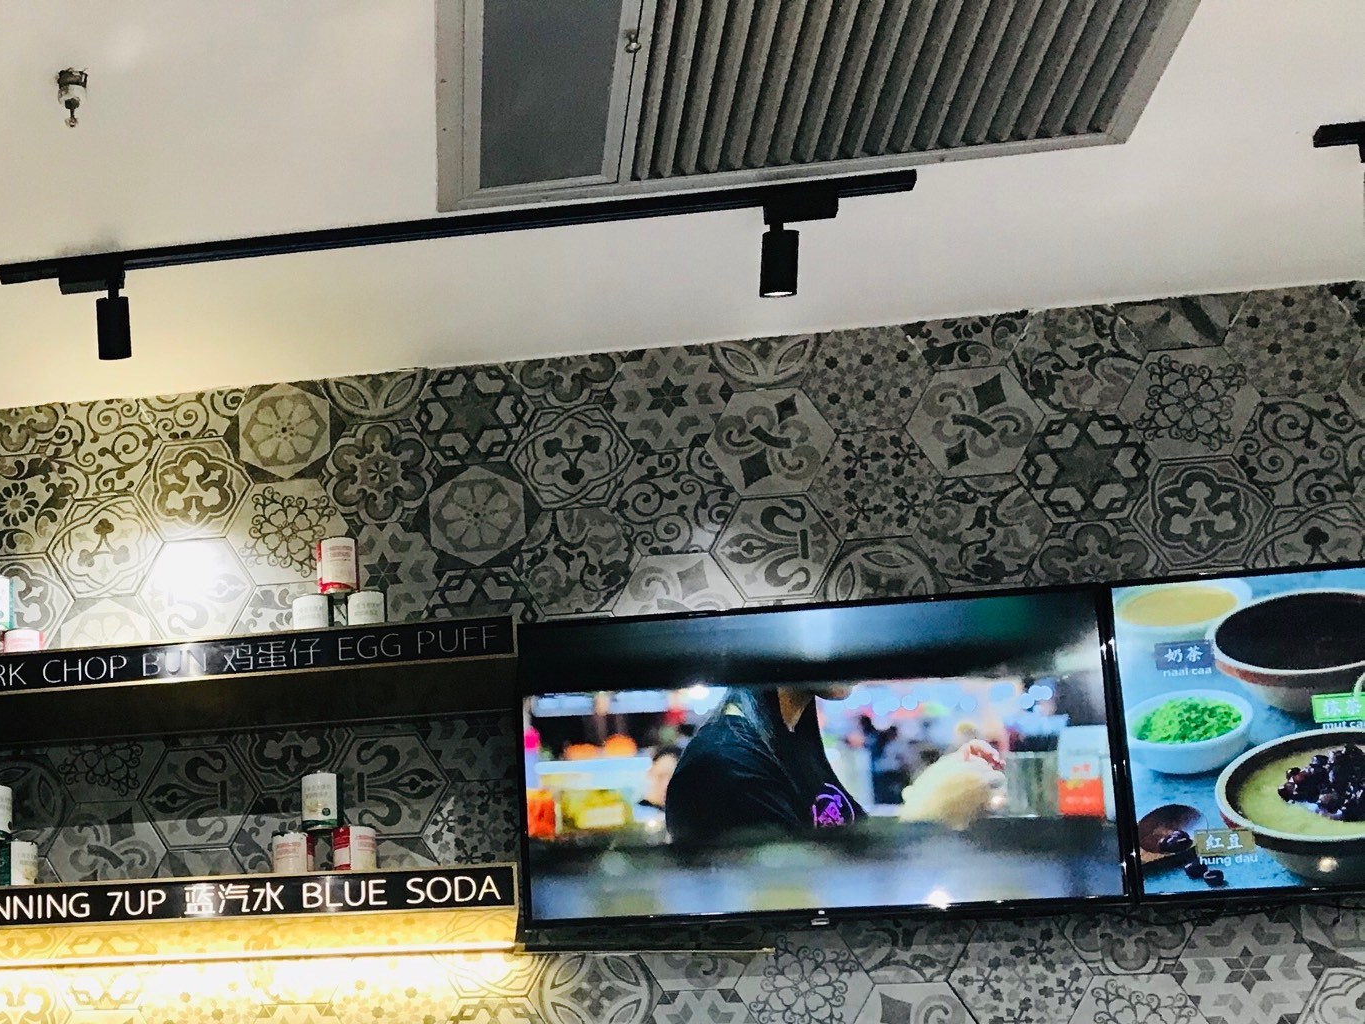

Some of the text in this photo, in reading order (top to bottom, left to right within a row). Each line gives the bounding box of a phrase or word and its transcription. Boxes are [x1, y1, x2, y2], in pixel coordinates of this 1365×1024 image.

[42, 654, 128, 684] CHOP
[142, 649, 208, 677] BUN
[222, 638, 322, 673] 鸡蛋仔
[337, 633, 402, 662] EGG
[417, 625, 498, 655] PUFF
[1164, 645, 1203, 663] 奶茶
[1199, 853, 1259, 867] hung dau
[107, 888, 167, 917] 7UP
[184, 882, 285, 915] 蓝汽水
[302, 878, 388, 909] BLUE
[406, 874, 502, 905] SODA
